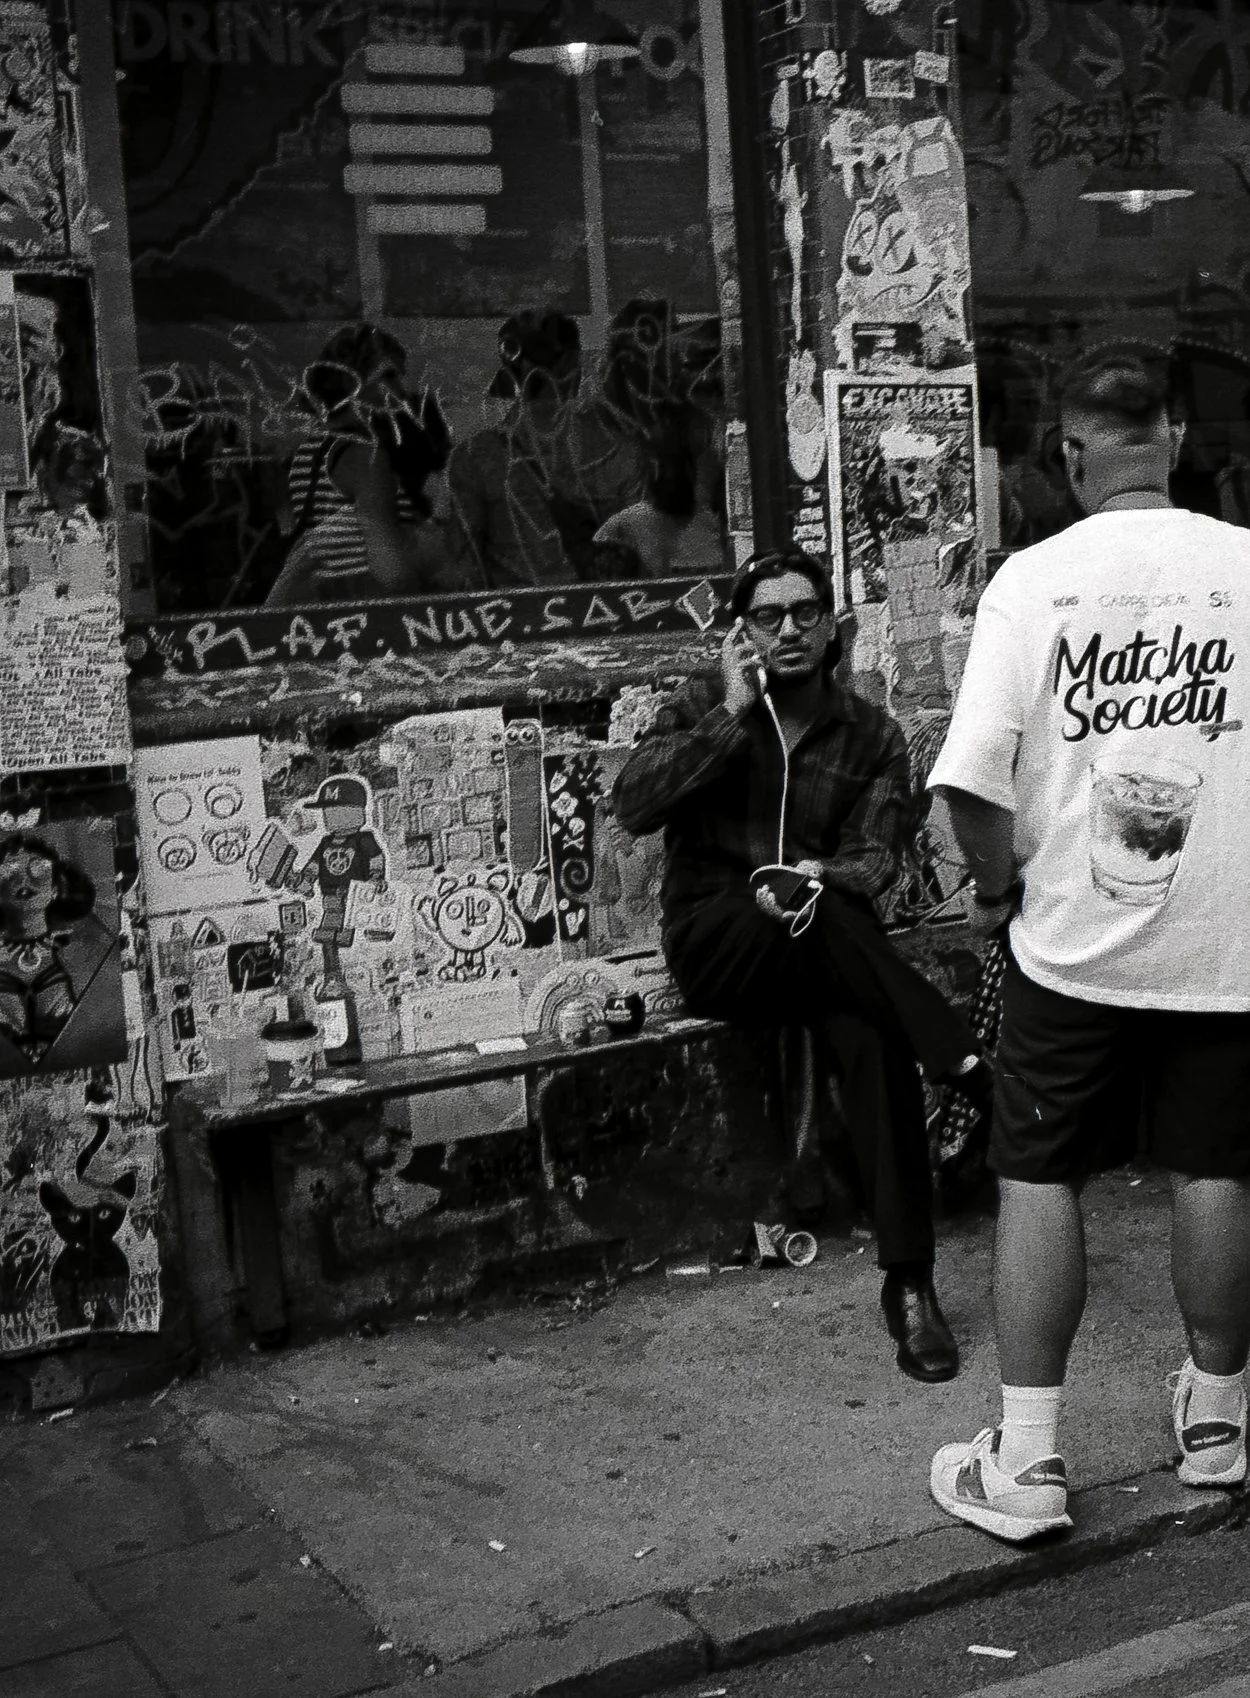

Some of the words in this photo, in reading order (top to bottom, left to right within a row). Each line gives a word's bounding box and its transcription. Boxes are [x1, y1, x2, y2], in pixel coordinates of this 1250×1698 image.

[119, 1, 338, 66] DRINK
[1053, 625, 1234, 699] Matcha
[1062, 672, 1230, 742] Society
[325, 785, 340, 799] M
